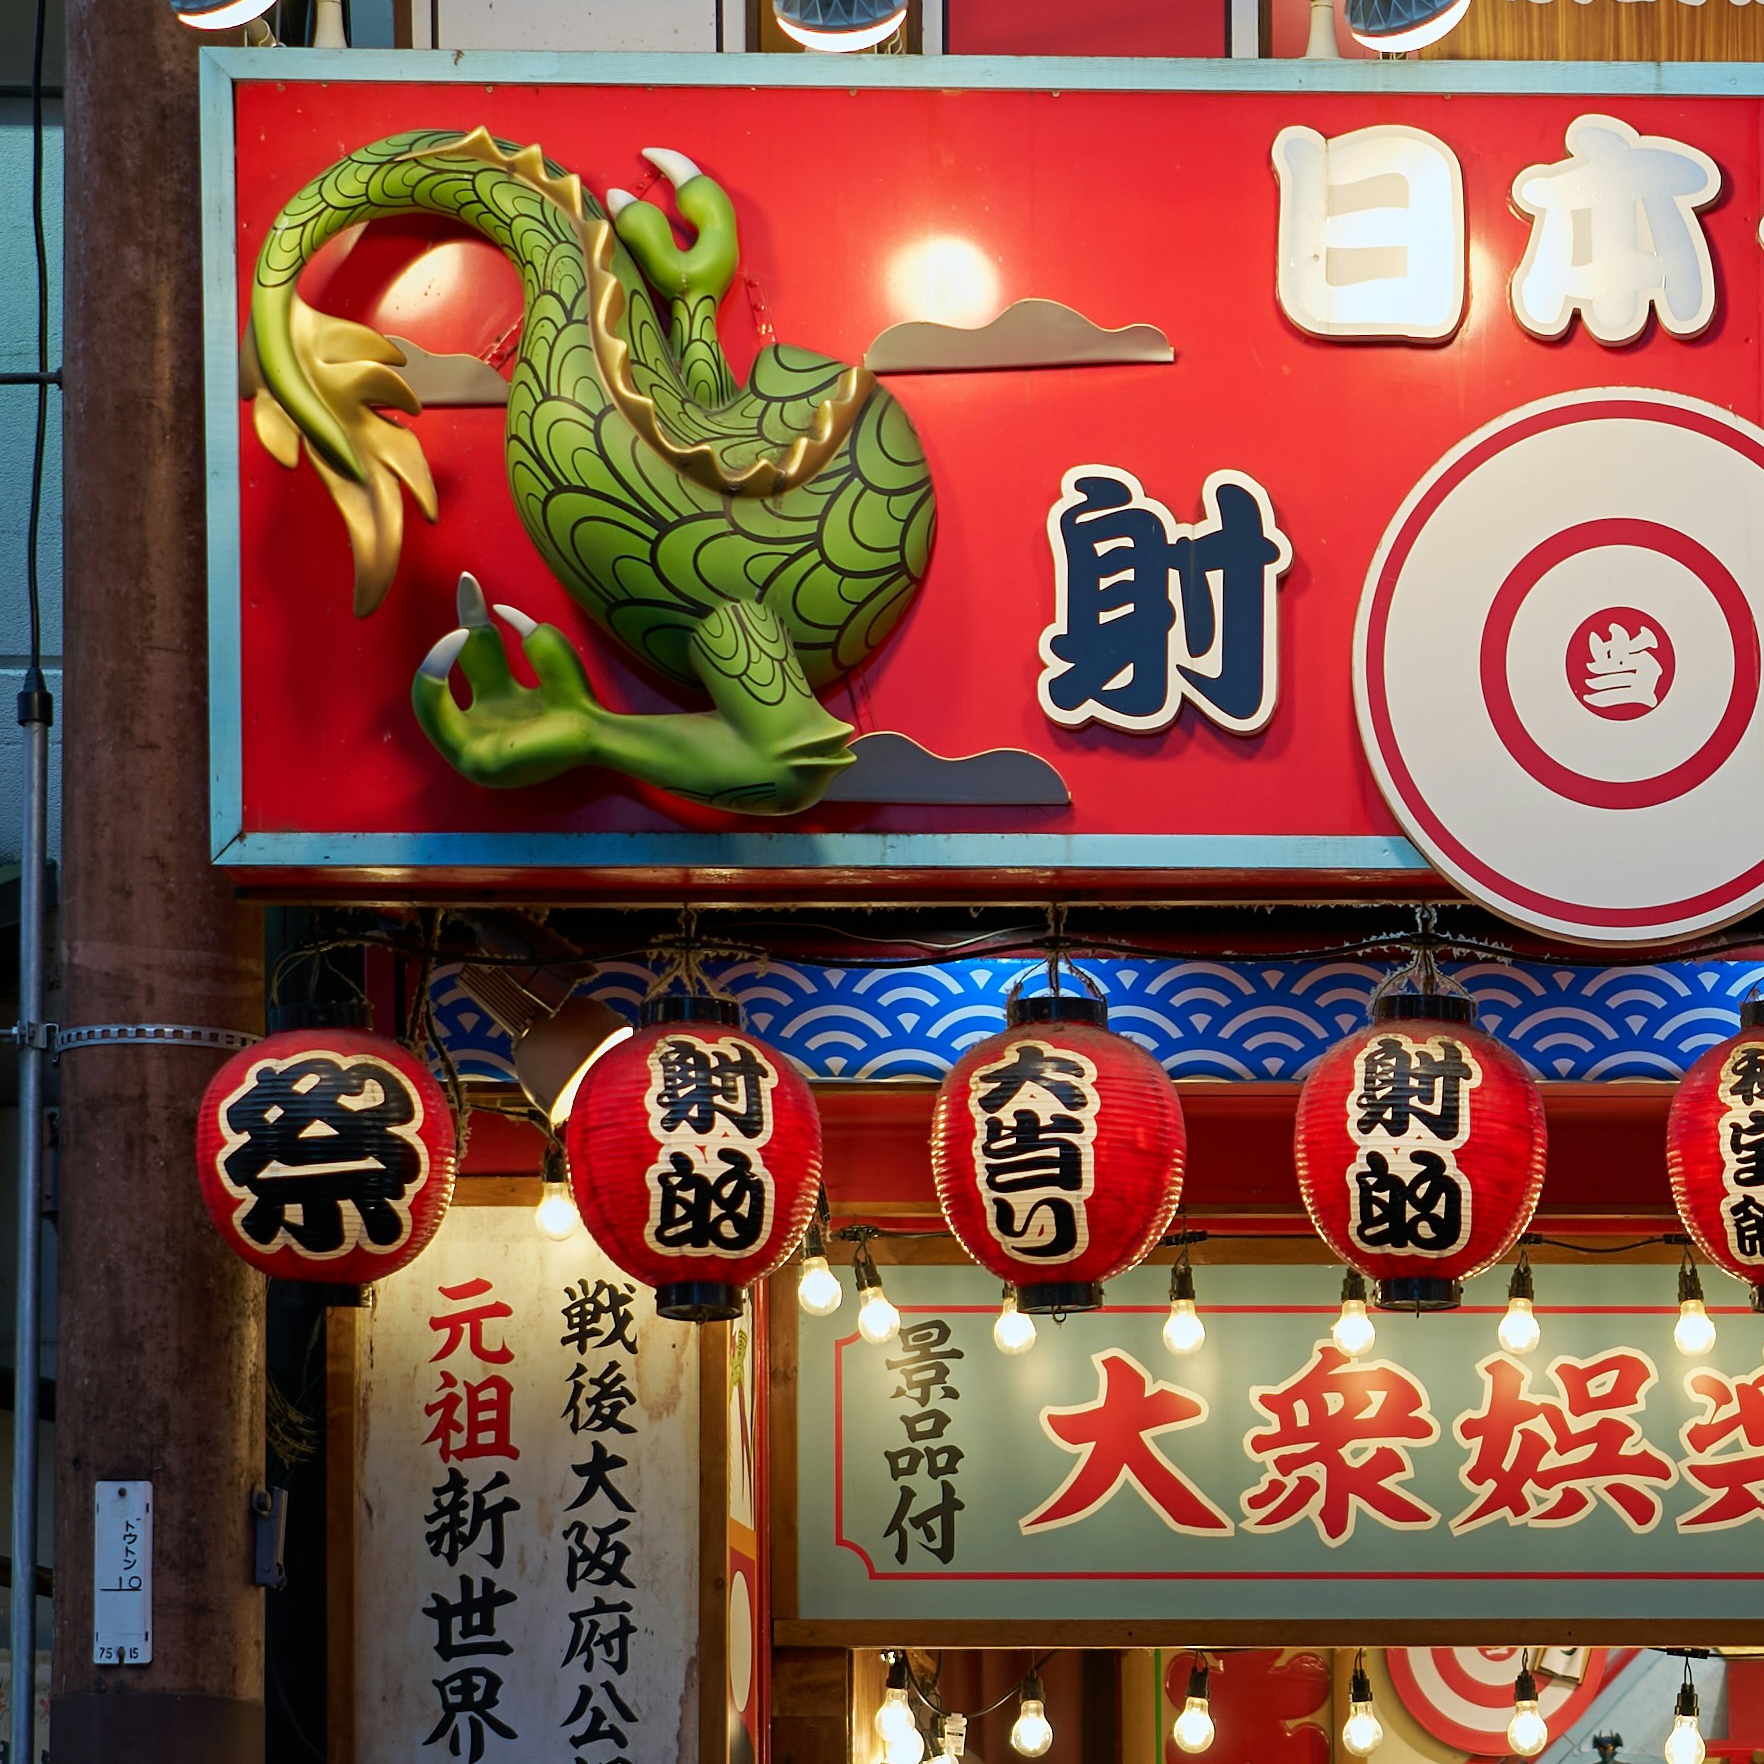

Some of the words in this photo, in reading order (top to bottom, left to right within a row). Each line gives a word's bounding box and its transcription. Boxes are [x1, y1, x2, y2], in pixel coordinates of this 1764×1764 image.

[222, 1056, 420, 1253] 祭
[653, 1037, 768, 1253] 射的
[982, 1043, 1098, 1259] 大当り
[1353, 1037, 1470, 1255] 射的
[884, 1319, 963, 1566] 景品付
[99, 1647, 113, 1660] 75
[129, 1647, 139, 1659] 15
